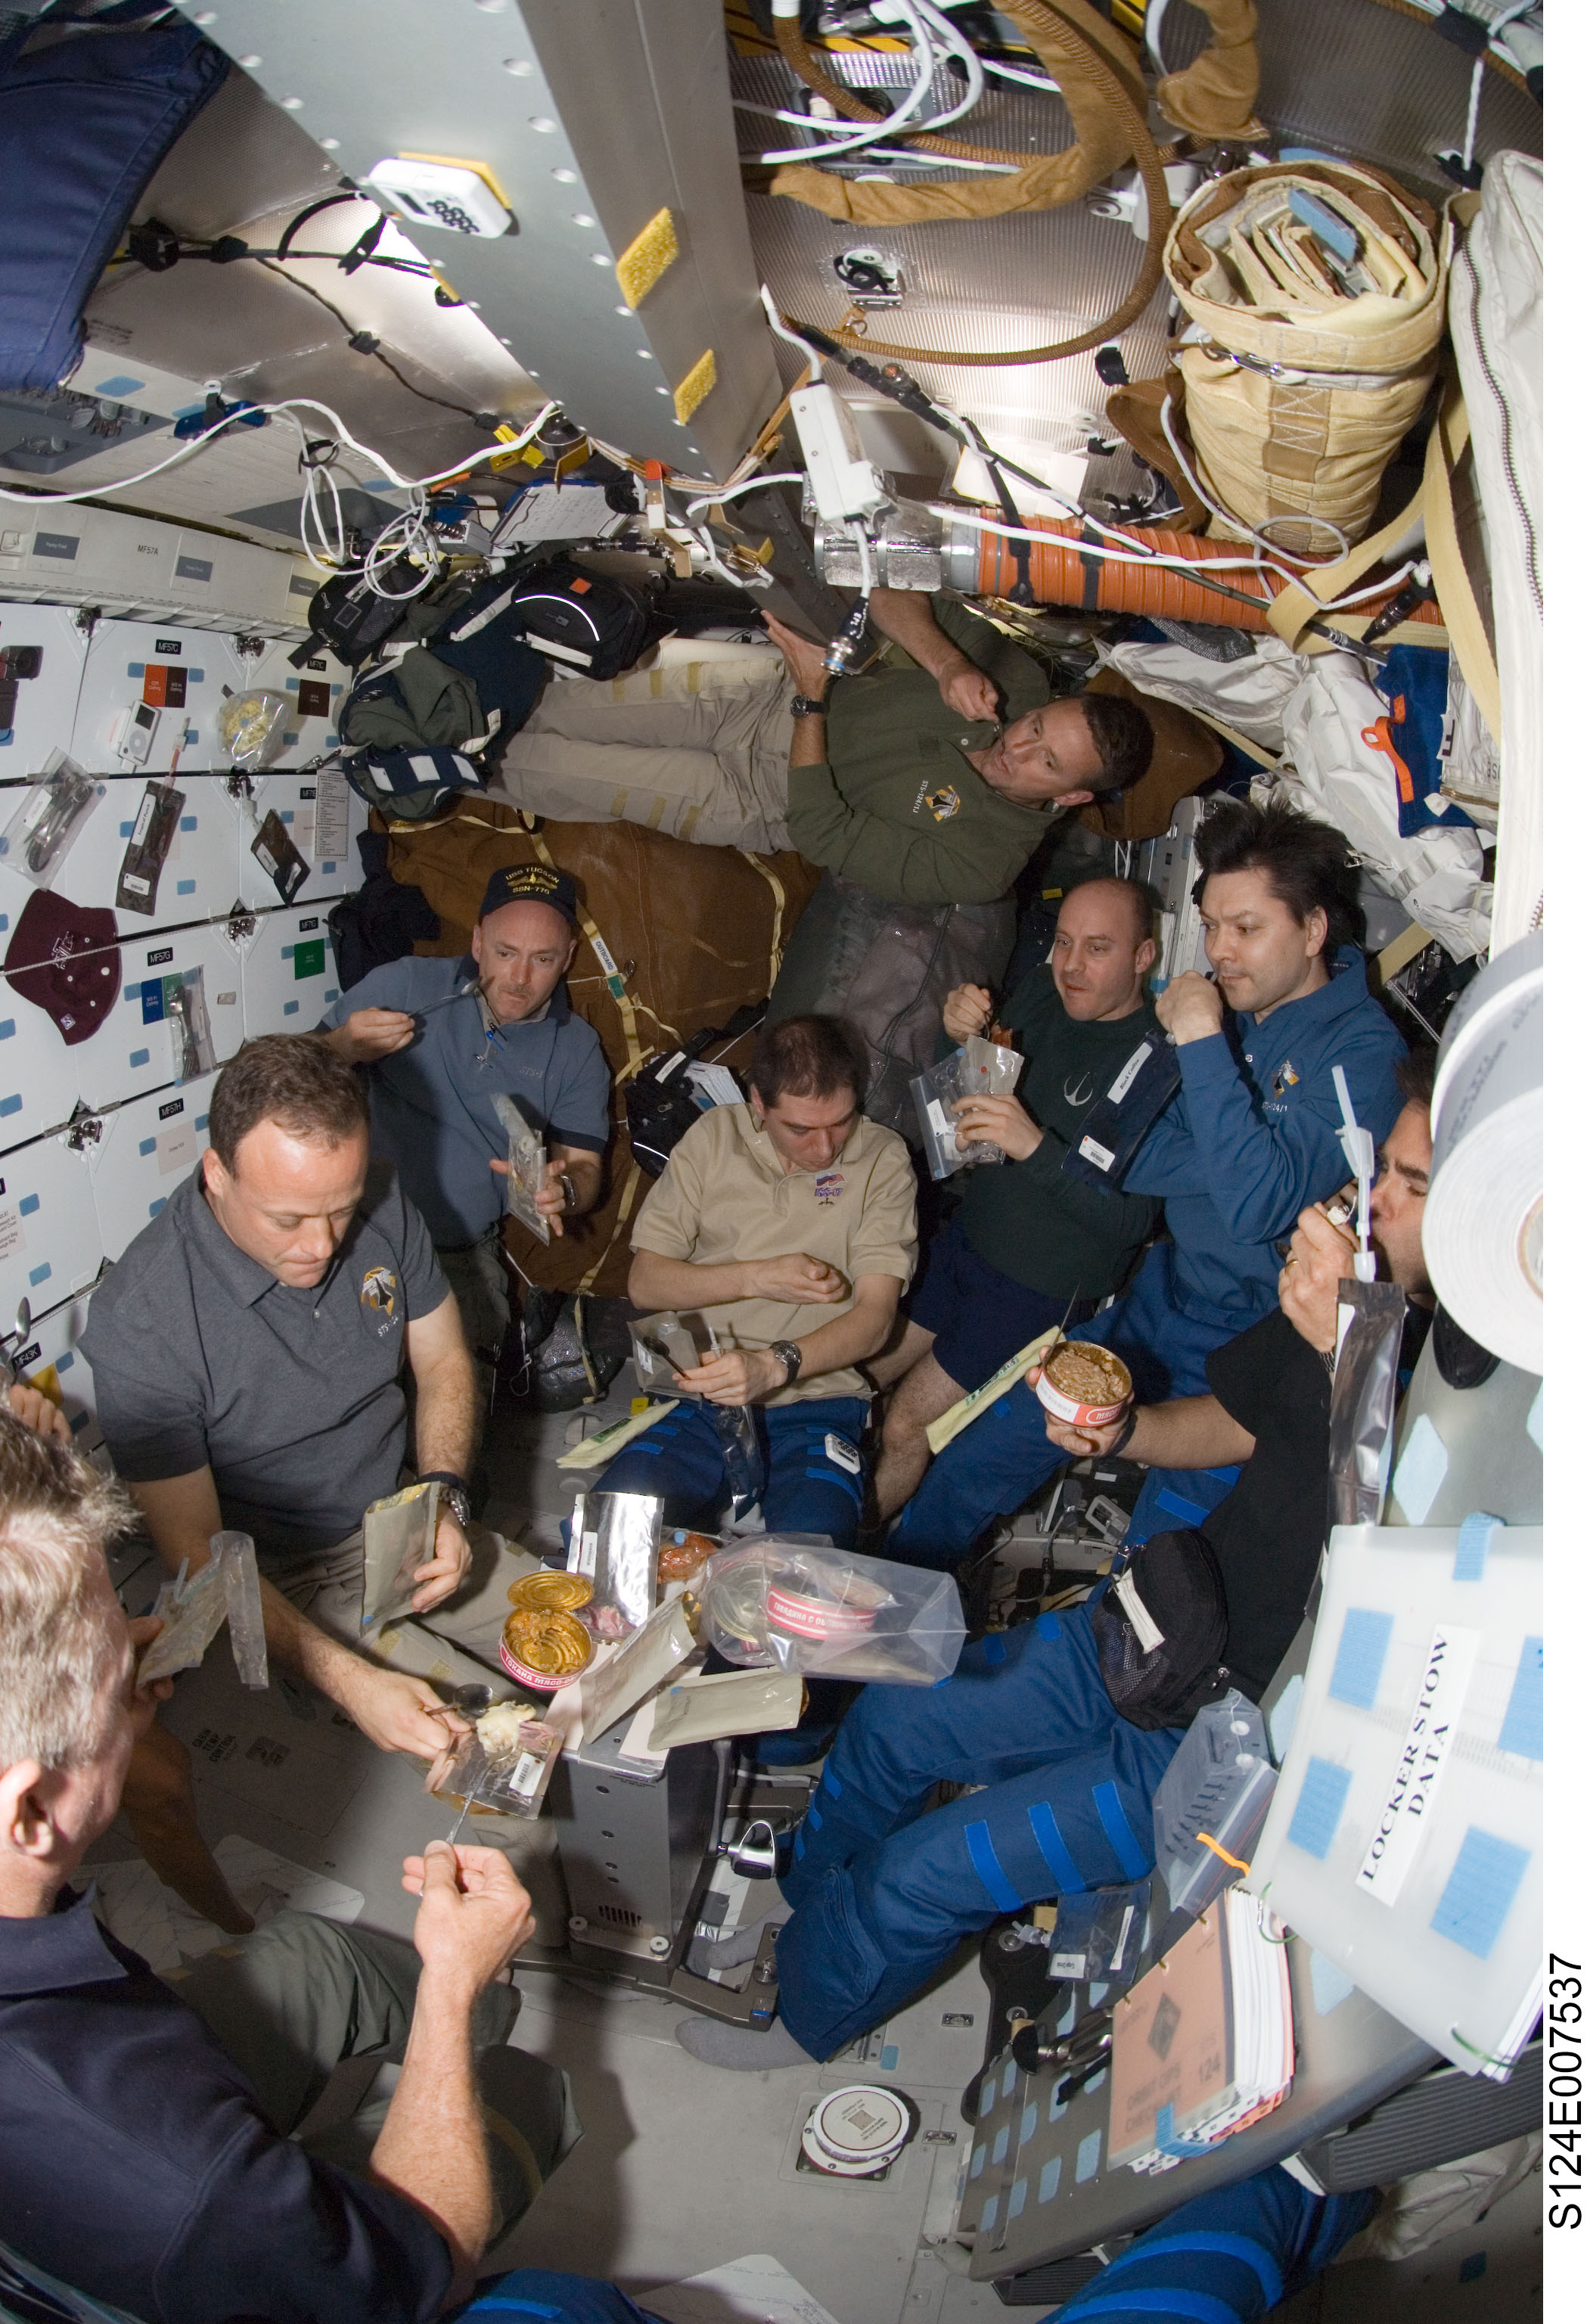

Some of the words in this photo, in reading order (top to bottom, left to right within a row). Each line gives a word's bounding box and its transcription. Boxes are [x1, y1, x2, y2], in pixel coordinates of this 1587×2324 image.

[137, 545, 158, 555] MF57A
[157, 642, 179, 652] MF57C
[505, 870, 523, 881] USS
[526, 867, 560, 884] TUCSON
[512, 886, 550, 895] SSN-770
[150, 950, 171, 963] MF57G
[595, 940, 614, 971] OUTBOARD
[1120, 1076, 1129, 1089] Black
[1128, 1058, 1139, 1075] Coffee
[161, 1101, 182, 1117] MF57H
[505, 1654, 533, 1681] ТОКАНА
[1362, 1743, 1419, 1881] LOCKER
[1413, 1633, 1448, 1736] STOW
[1408, 1724, 1449, 1816] DATA
